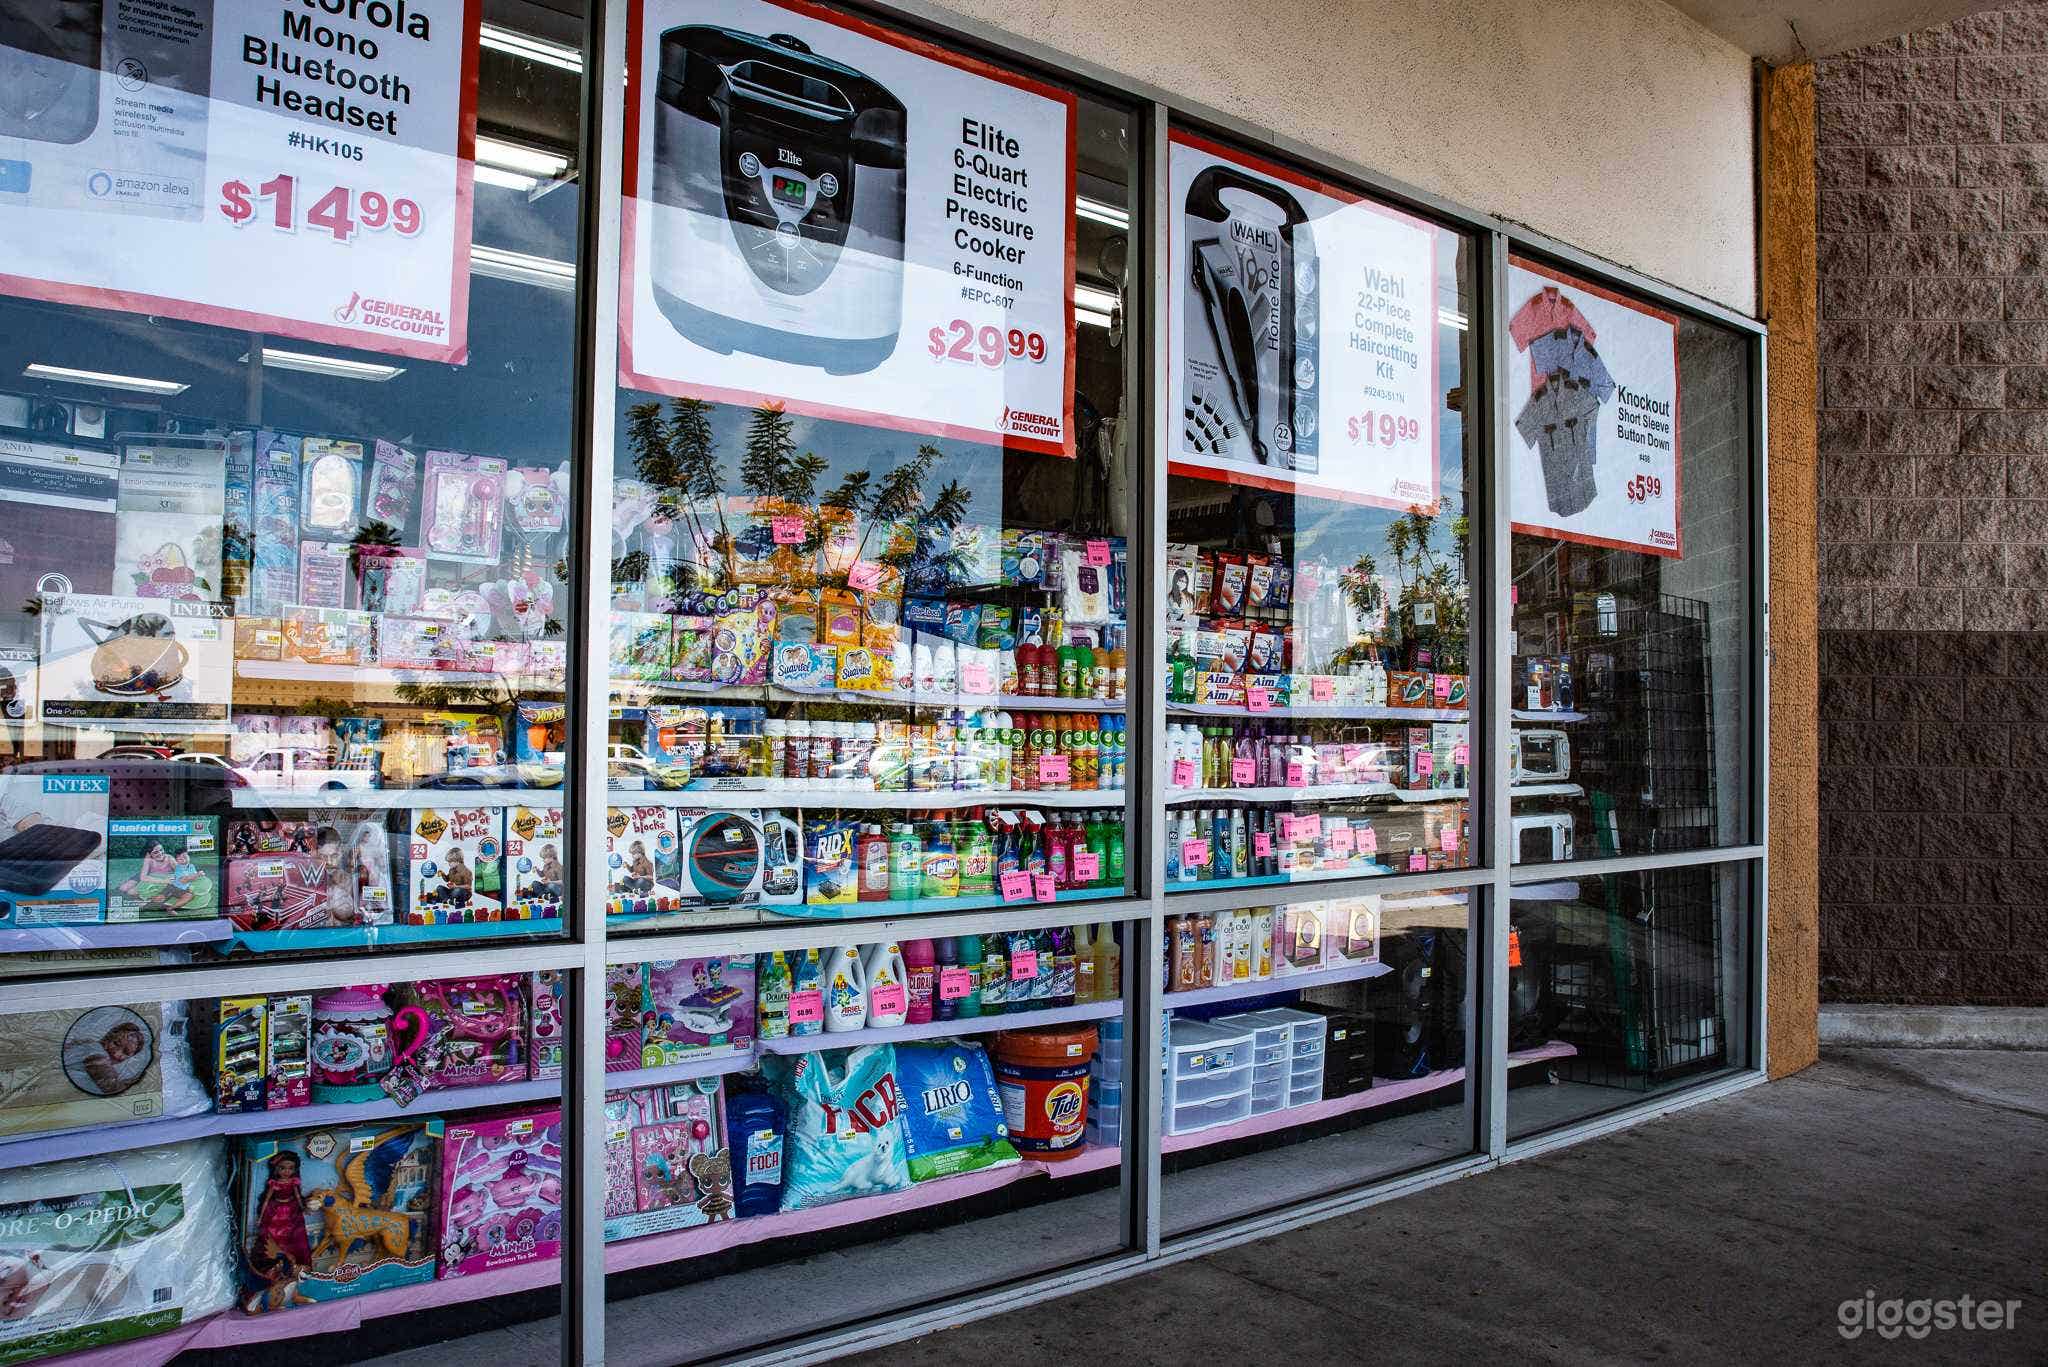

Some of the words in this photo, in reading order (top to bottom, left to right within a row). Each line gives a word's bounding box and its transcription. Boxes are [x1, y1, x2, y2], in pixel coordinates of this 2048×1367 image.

[282, 10, 379, 60] Mono
[243, 34, 410, 104] Bluetooth
[115, 96, 147, 110] Stream
[149, 103, 174, 114] media
[256, 75, 397, 136] Headset
[115, 109, 157, 122] wirelessly
[288, 130, 364, 161] #HK105
[962, 117, 1020, 159] Elite
[778, 148, 802, 166] Elite
[954, 148, 1028, 188] 6-Quart
[115, 177, 160, 193] amazon
[162, 180, 189, 196] alexa
[953, 174, 1028, 213] Electric
[946, 198, 1034, 241] Pressure
[1234, 222, 1273, 249] WAHL
[954, 229, 1025, 265] Cooker
[953, 261, 1023, 291] 6-Function
[1268, 259, 1280, 290] Pro
[1364, 266, 1404, 299] Wahl
[961, 287, 1014, 310] #EPC-607
[1357, 292, 1411, 321] 22-Piece
[360, 298, 444, 326] GENERAL
[362, 314, 446, 337] DISCOUNT
[1268, 295, 1280, 351] Home
[1355, 312, 1414, 343] Complete
[1350, 332, 1418, 369] Haircutting
[1376, 361, 1395, 379] Kit
[1618, 384, 1670, 417] Knockout
[1009, 409, 1060, 428] GENERAL
[1618, 407, 1641, 426] Short
[1643, 414, 1669, 434] Sleeve
[1011, 422, 1061, 438] DISCOUNT
[1277, 427, 1289, 440] 22
[1618, 425, 1645, 446] Button
[1647, 433, 1670, 452] Down
[66, 474, 87, 484] Panel
[1653, 530, 1676, 540] GENERAL
[1654, 538, 1676, 547] DISCOUNT
[93, 599, 108, 609] Air
[111, 600, 144, 611] Pump
[173, 602, 229, 617] INTEX
[778, 661, 811, 677] Suavitel
[842, 666, 872, 681] Suavitel
[1206, 674, 1230, 685] Aim
[1252, 675, 1275, 687] Aim
[1206, 689, 1229, 701] Aim
[46, 708, 62, 716] One
[64, 709, 87, 717] Pump
[47, 779, 104, 793] INTEX
[455, 807, 485, 827] box
[480, 816, 490, 824] of
[679, 808, 706, 817] Wilson
[112, 824, 155, 832] Comfort
[452, 826, 488, 841] blocks
[633, 819, 665, 834] blocks
[816, 829, 854, 860] RID-X
[71, 877, 98, 888] TWIN
[647, 1056, 656, 1065] 19
[923, 1080, 972, 1115] LIRIO
[1050, 1093, 1081, 1121] Tide
[750, 1152, 779, 1171] FOCA
